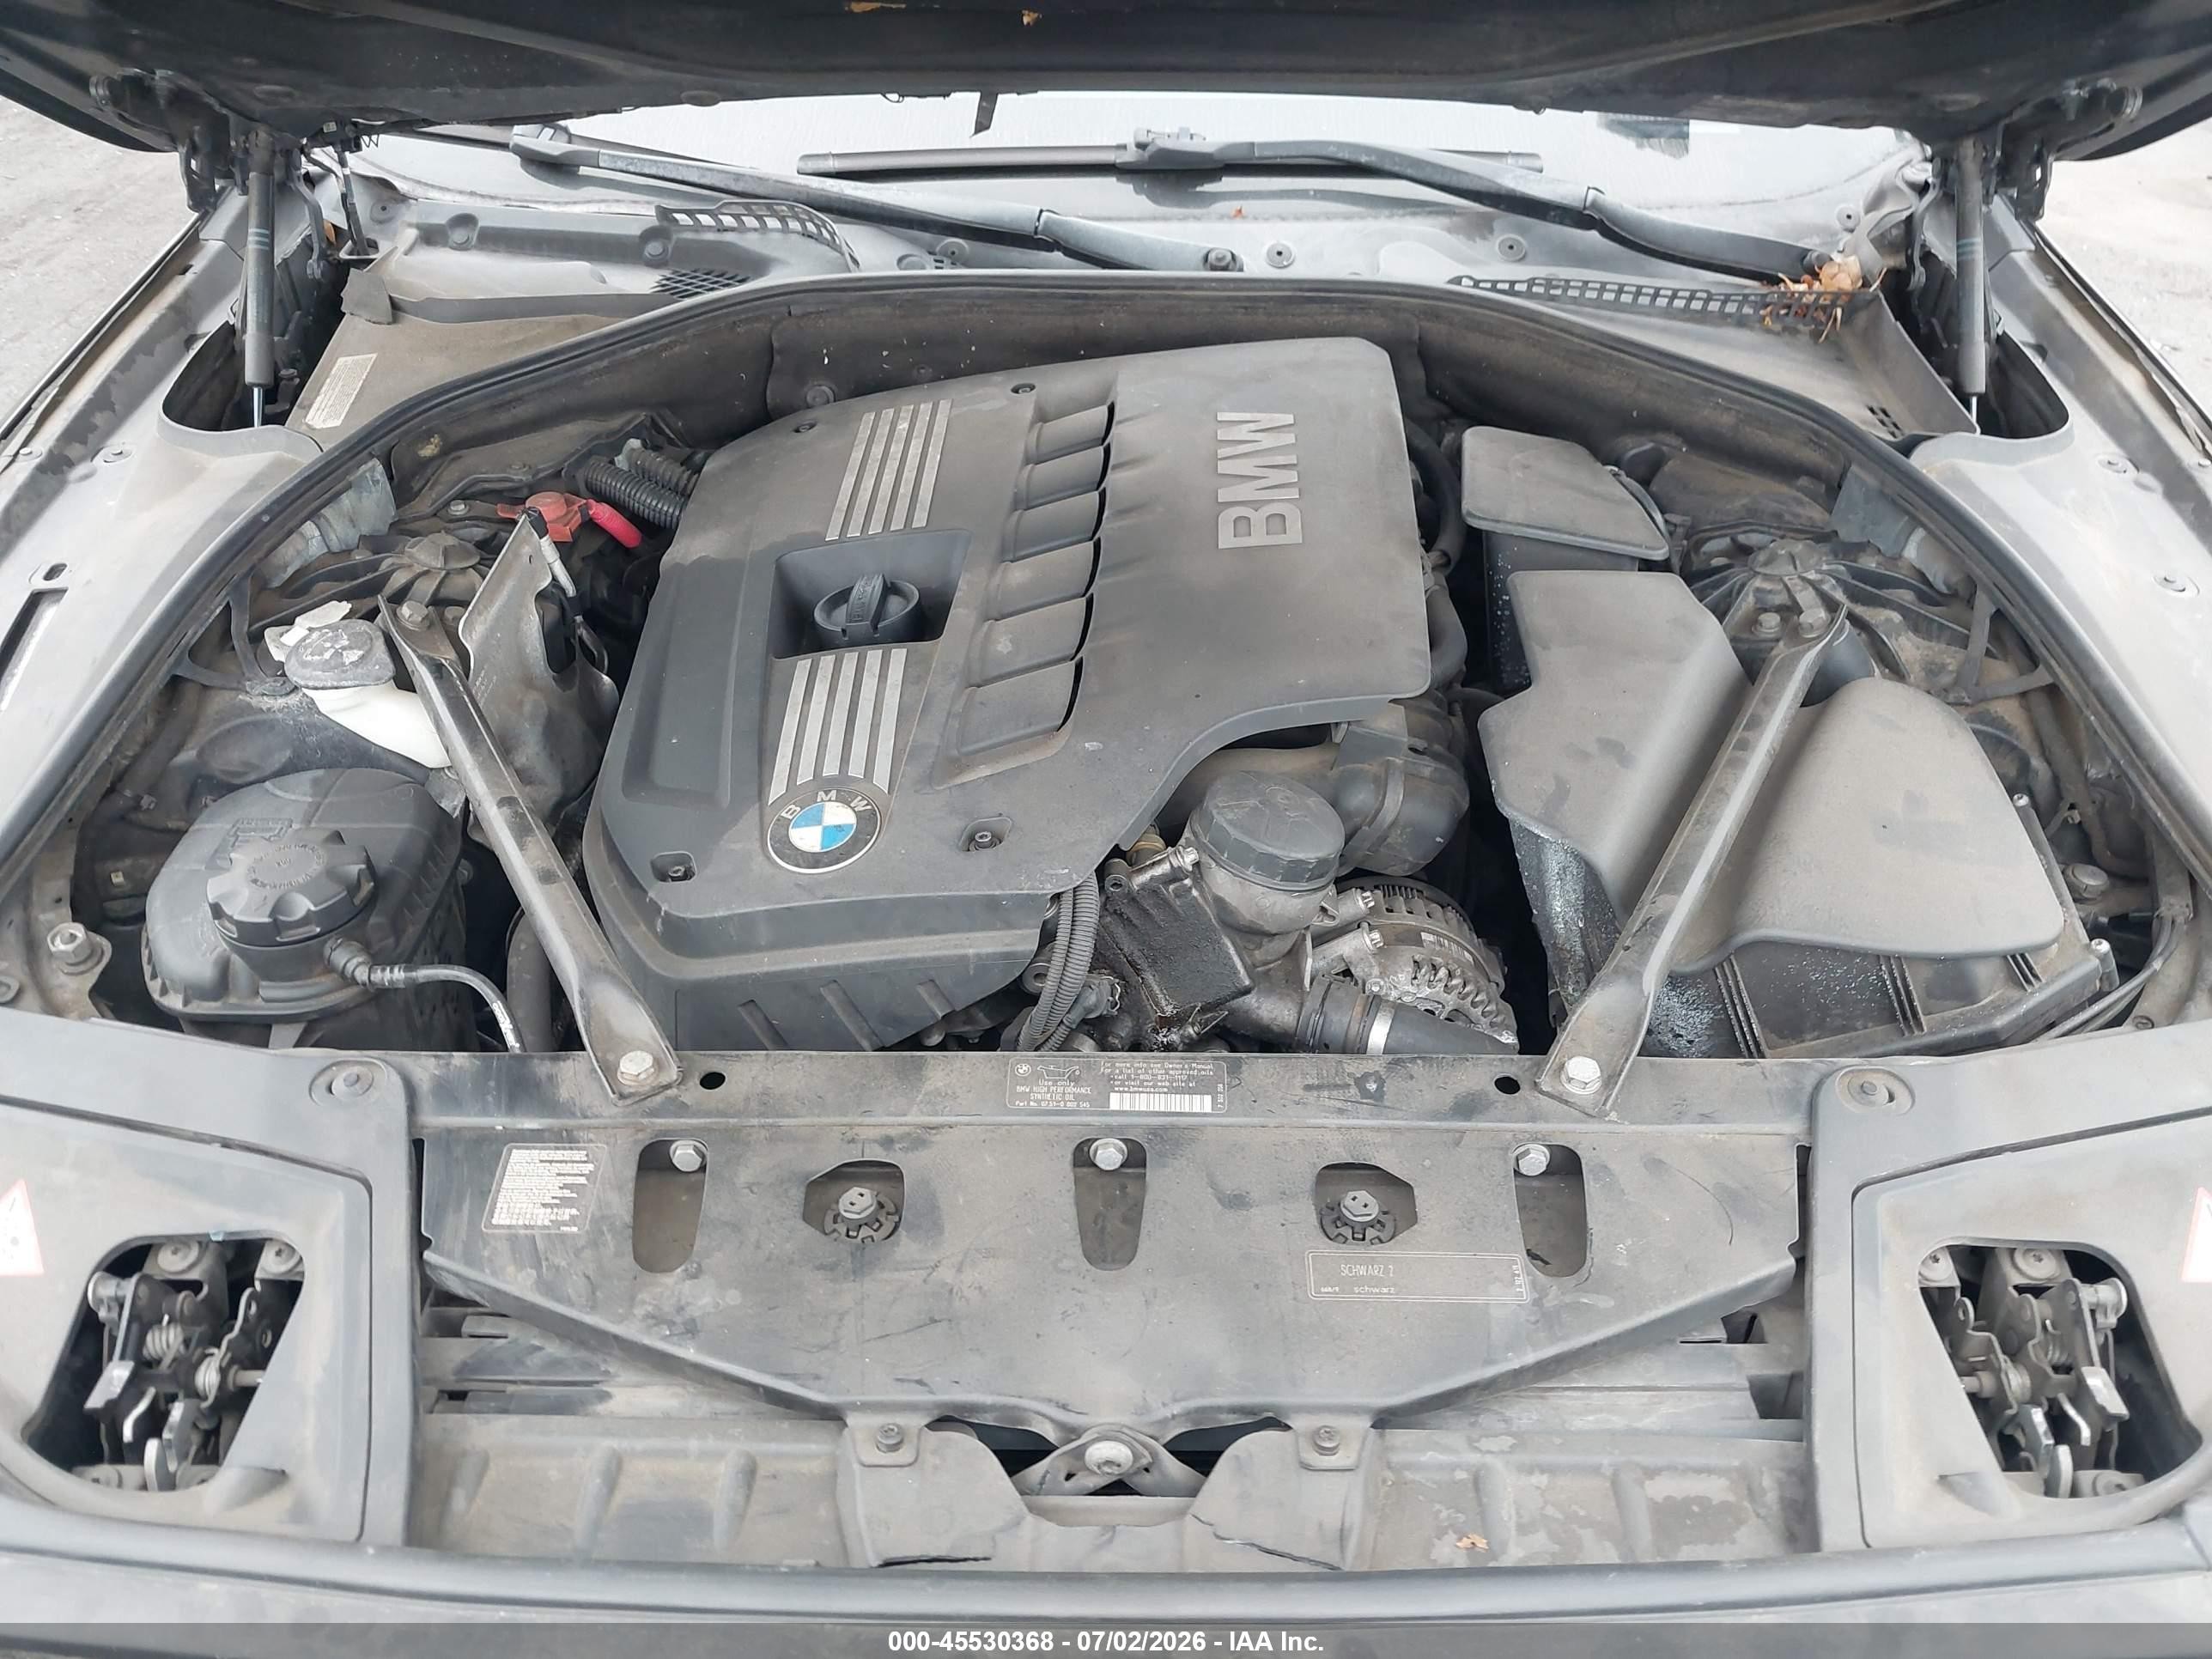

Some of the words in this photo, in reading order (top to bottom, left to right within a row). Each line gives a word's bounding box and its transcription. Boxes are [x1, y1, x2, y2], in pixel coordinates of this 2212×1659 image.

[1217, 412, 1303, 549] BMW
[780, 789, 872, 820] BMW
[1058, 1079, 1075, 1088] only
[1050, 1085, 1092, 1095] PERFORMANCE
[1340, 1264, 1385, 1277] SCHWARZ
[1353, 1285, 1395, 1293] schwarz
